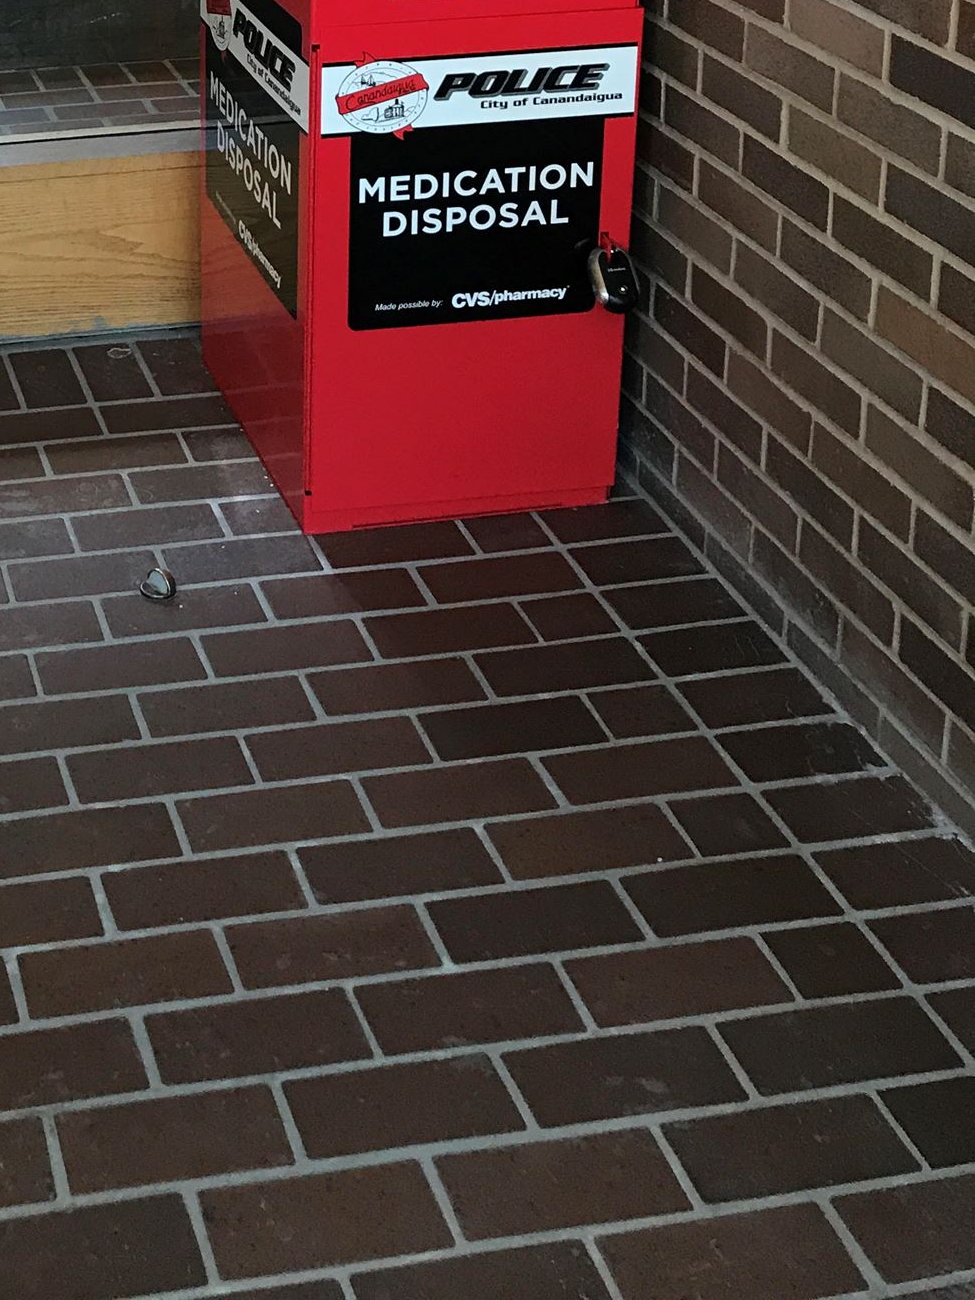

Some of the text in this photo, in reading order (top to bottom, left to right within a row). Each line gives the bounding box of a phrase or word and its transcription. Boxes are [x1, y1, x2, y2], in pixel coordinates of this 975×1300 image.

[233, 8, 296, 92] POLICE
[434, 63, 610, 102] POLICE
[481, 92, 622, 110] City of Canandaigua
[210, 70, 291, 195] MEDICATION
[217, 123, 281, 229] DISPOSAL
[359, 161, 594, 203] MEDICATION
[383, 199, 569, 237] DISPOSAL
[375, 287, 567, 311] Made possible by: CVS/pharmacy
